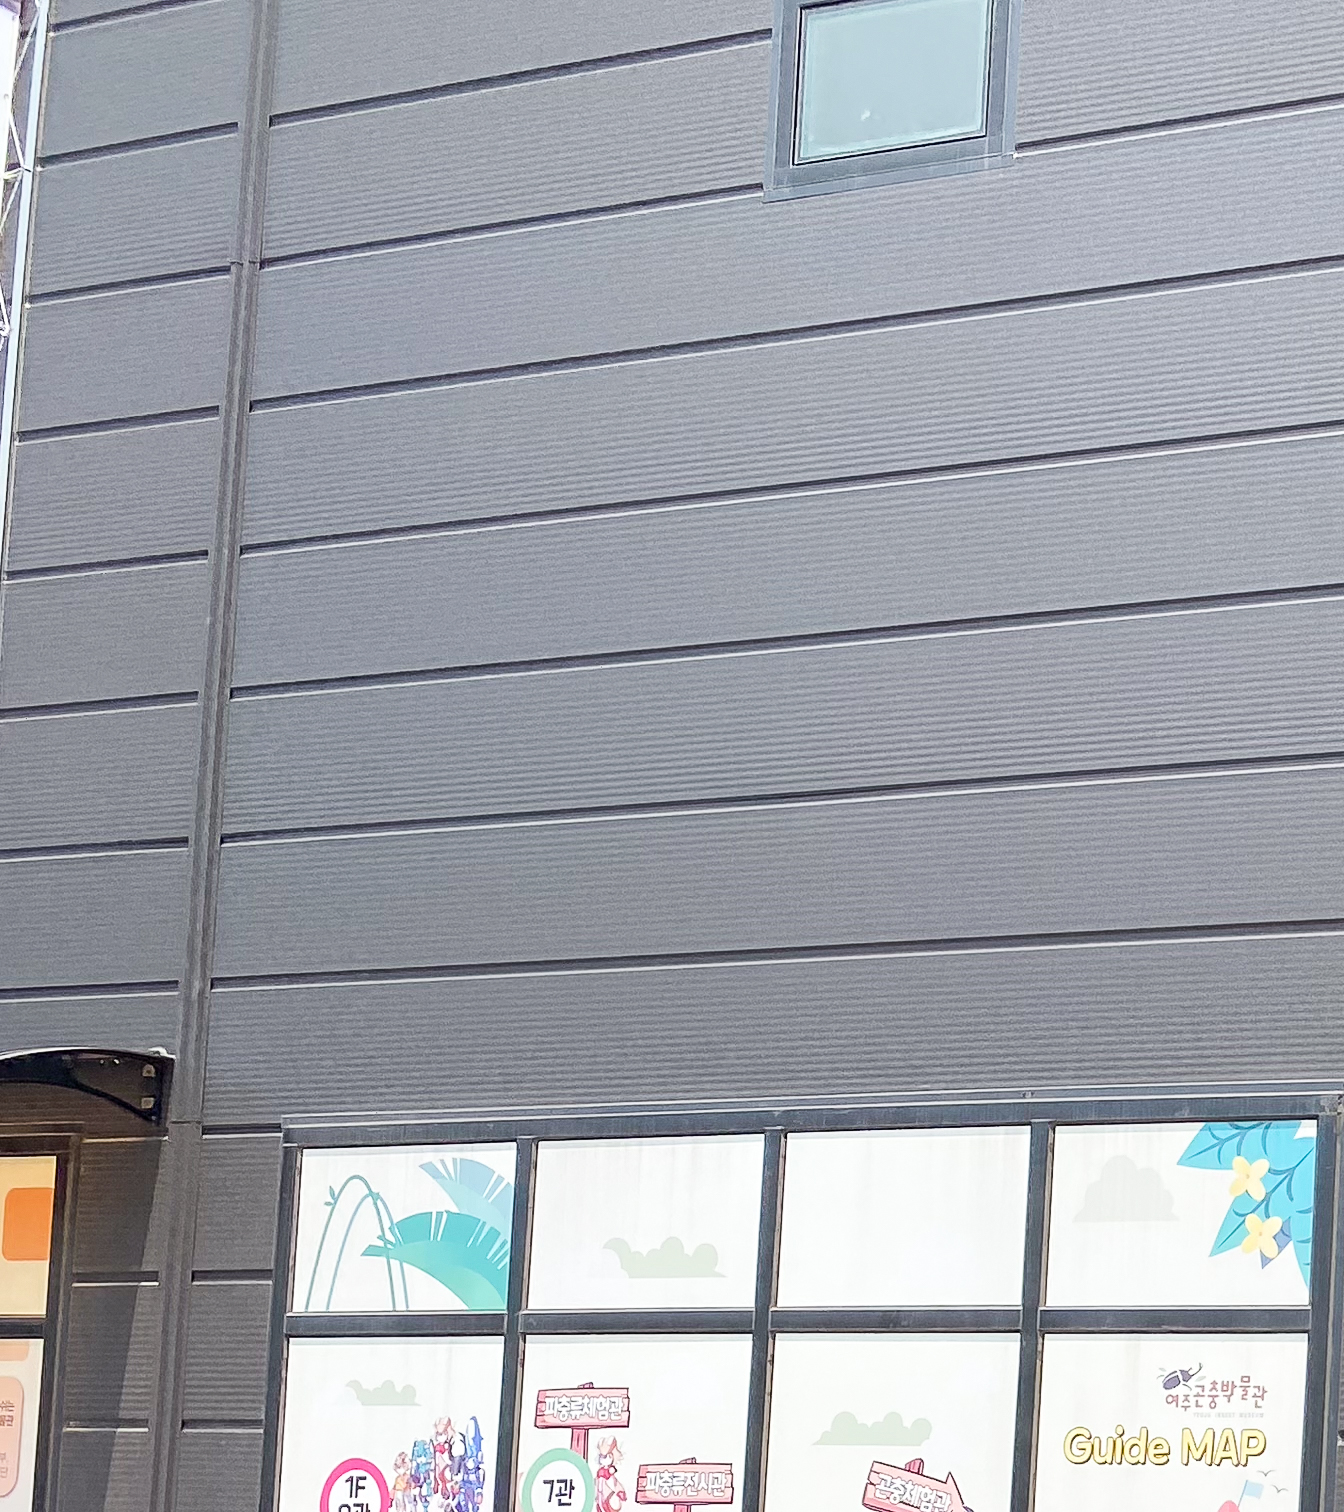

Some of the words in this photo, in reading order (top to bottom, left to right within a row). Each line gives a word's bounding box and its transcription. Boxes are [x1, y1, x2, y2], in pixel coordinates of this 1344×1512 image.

[1165, 1375, 1268, 1412] 여주곤충박물관
[544, 1394, 624, 1421] 파충류체험관
[1063, 1425, 1170, 1466] Guide
[1180, 1427, 1267, 1468] MAP
[345, 1475, 367, 1499] 1F
[543, 1478, 575, 1506] 7관
[645, 1470, 728, 1497] 파충류전시관
